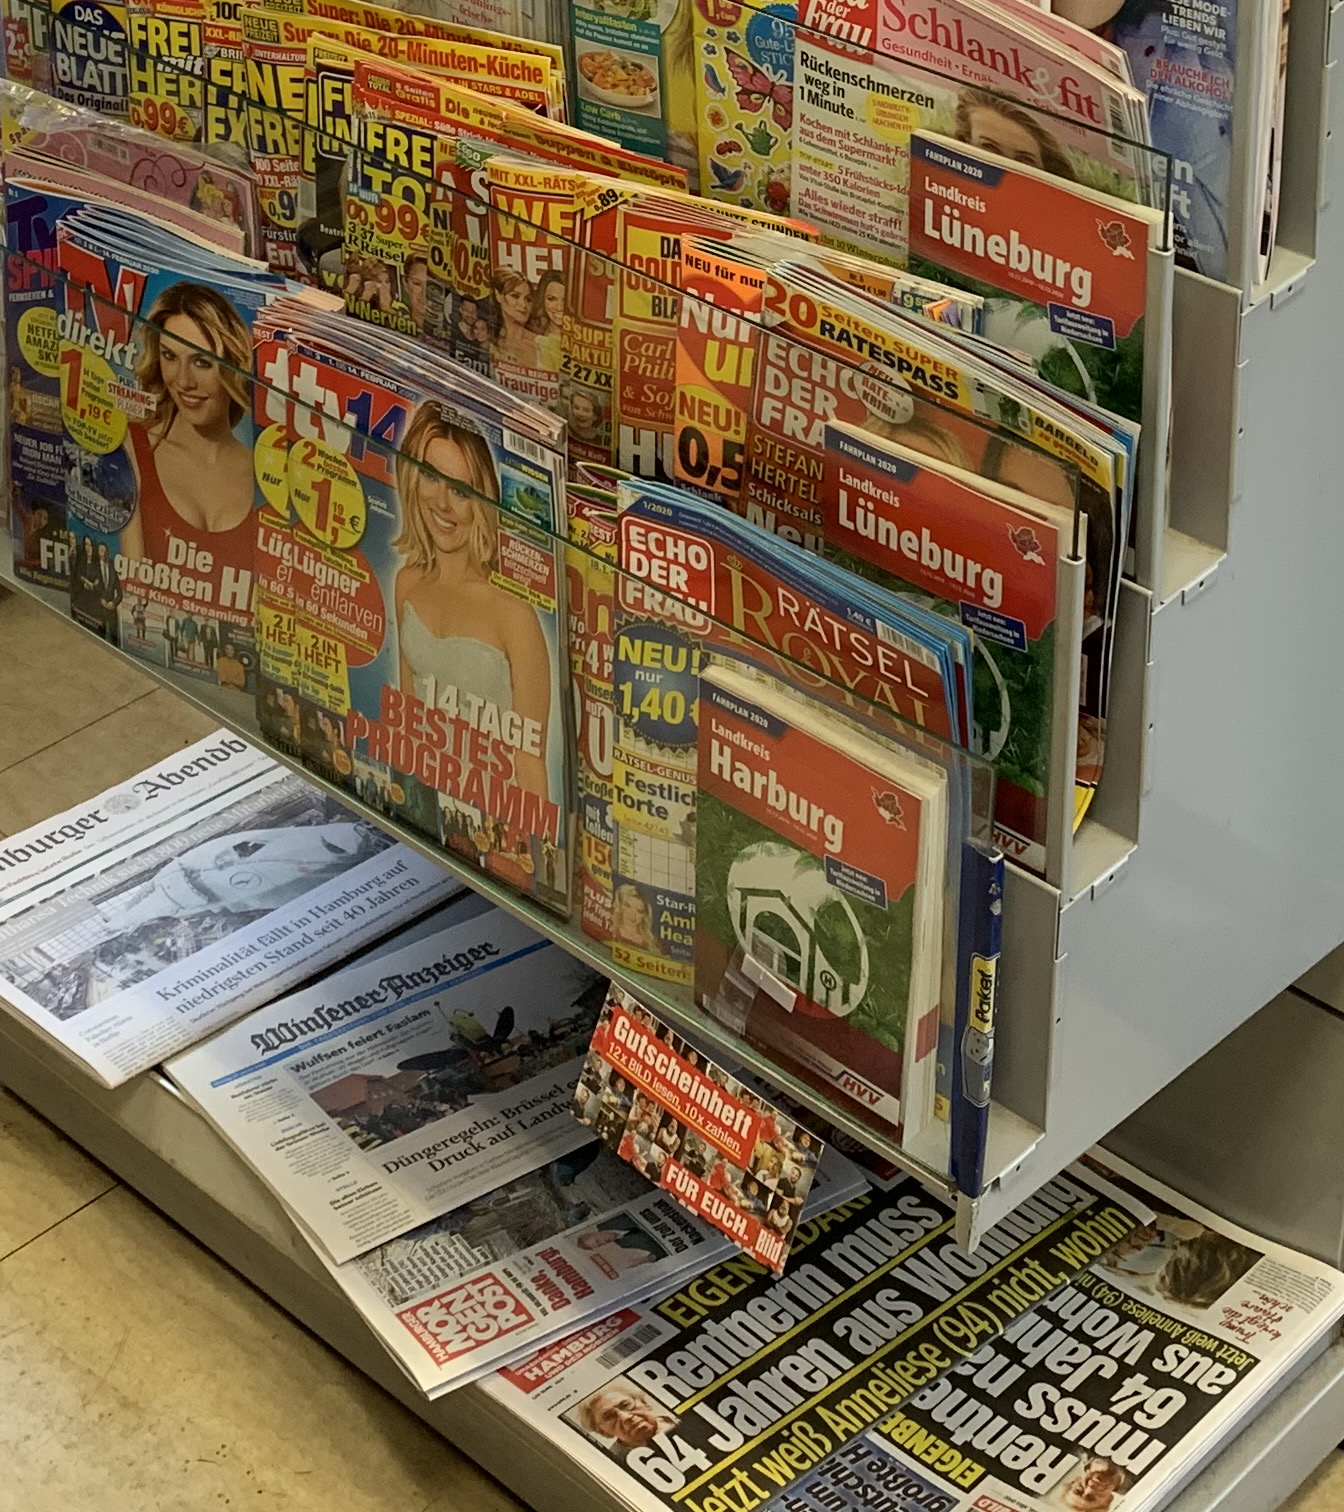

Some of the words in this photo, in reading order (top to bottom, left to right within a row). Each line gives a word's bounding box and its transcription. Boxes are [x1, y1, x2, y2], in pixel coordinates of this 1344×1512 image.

[345, 28, 372, 51] Die
[376, 35, 543, 83] 20-Minuten-Küche
[802, 0, 872, 56] Frau
[800, 50, 935, 110] Rückenschmerzen
[1059, 77, 1101, 125] fit
[925, 149, 962, 170] FAHRPLAN
[963, 163, 983, 179] 2020
[925, 176, 986, 212] Landkreis
[923, 197, 1093, 307] Lüneburg
[58, 309, 138, 371] direkt
[763, 279, 818, 331] 20
[821, 304, 886, 346] Seiten
[893, 339, 959, 380] SUPER
[820, 324, 959, 400] RATESPASS
[839, 470, 900, 508] Landkreis
[114, 554, 213, 602] größten
[167, 536, 213, 573] Die
[293, 553, 360, 598] Lügner
[629, 526, 708, 570] ECHO
[630, 553, 688, 591] DER
[838, 490, 1004, 608] Lüneburg
[310, 581, 382, 633] entlarven
[625, 583, 708, 629] FRAU
[777, 588, 929, 698] RÄTSEL
[381, 685, 514, 784] BESTES
[468, 690, 543, 758] TAGE
[711, 718, 770, 761] Landkreis
[346, 708, 561, 850] PROGRAMM
[709, 740, 844, 853] Harburg
[156, 940, 260, 1004] Kriminalität
[261, 920, 293, 949] fällt
[297, 914, 310, 931] in
[311, 871, 382, 927] Hamburg
[380, 859, 409, 884] auf
[175, 960, 266, 1017] niedrigsten
[264, 933, 314, 973] Stand
[313, 919, 342, 944] seit
[342, 906, 365, 925] 40
[363, 874, 420, 917] Jahren
[382, 939, 501, 1003] Anzeiger
[612, 1014, 754, 1141] Gutscheinheft
[382, 1109, 499, 1177] Düngeregeln:
[498, 1079, 562, 1126] Brüssel
[427, 1140, 481, 1176] Druck
[485, 1129, 518, 1160] auf
[665, 1162, 701, 1199] FÜR
[702, 1193, 749, 1240] EUCH.
[755, 1230, 783, 1264] Bild
[628, 1252, 837, 1404] Rentnerin
[831, 1189, 945, 1273] muss
[825, 1341, 953, 1446] Anneliese
[935, 1299, 1005, 1361] (94)
[985, 1251, 1068, 1319] nicht,
[1050, 1205, 1136, 1273] wohin
[523, 1316, 623, 1382] HAMBURG
[625, 1425, 714, 1492] 64
[693, 1339, 844, 1454] Jahren
[834, 1285, 925, 1357] aus
